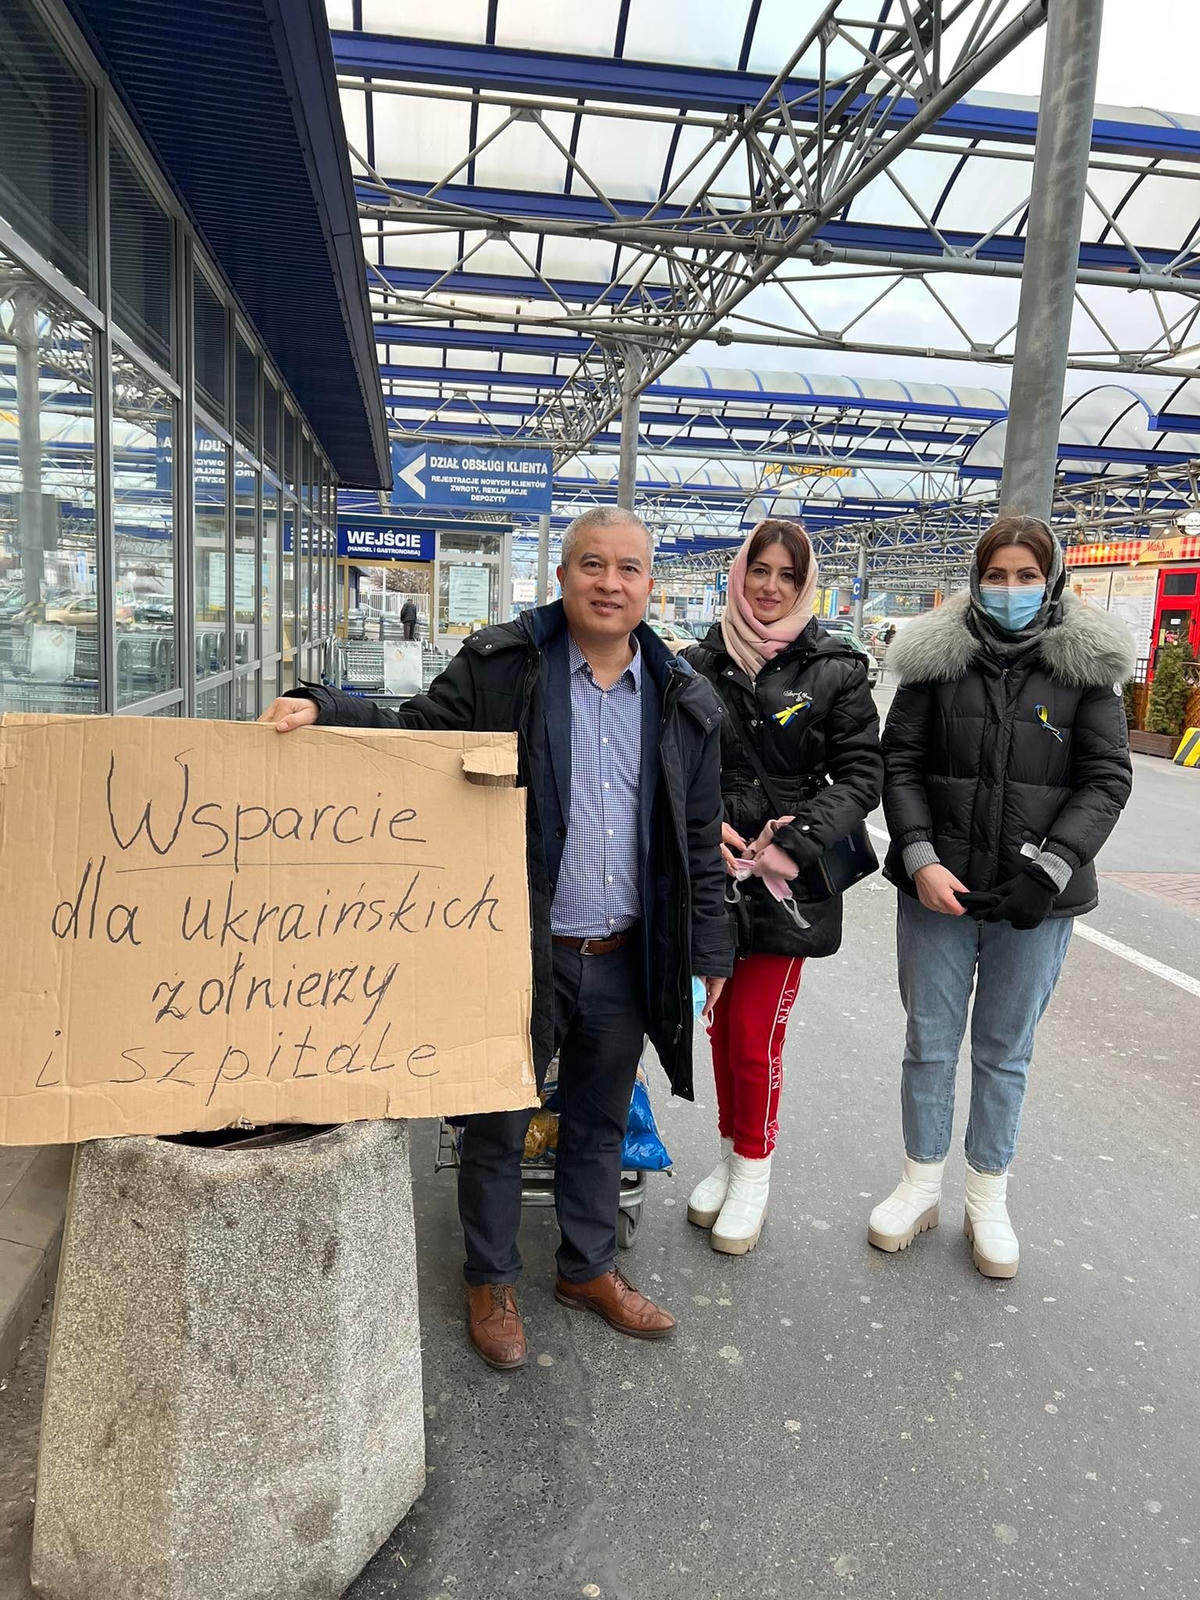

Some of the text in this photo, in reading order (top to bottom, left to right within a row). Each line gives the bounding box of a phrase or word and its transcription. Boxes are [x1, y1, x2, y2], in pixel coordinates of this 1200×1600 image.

[430, 456, 548, 475] DZIAŁ OBSŁUGI KLIENTA
[431, 475, 547, 488] REJESTRACJE NOWYCH KLIENTÓW
[450, 485, 528, 496] ZWROTY, REKLAMACJE
[470, 494, 507, 503] DEPOZYTY
[346, 530, 421, 548] WEJŚCIE
[720, 573, 729, 585] P
[853, 583, 860, 595] C
[107, 748, 427, 873] Wsparcie
[52, 855, 504, 948] dla ukraińskich
[777, 989, 795, 1024] VLTN
[35, 1030, 60, 1088] i
[771, 1056, 781, 1090] VLTN
